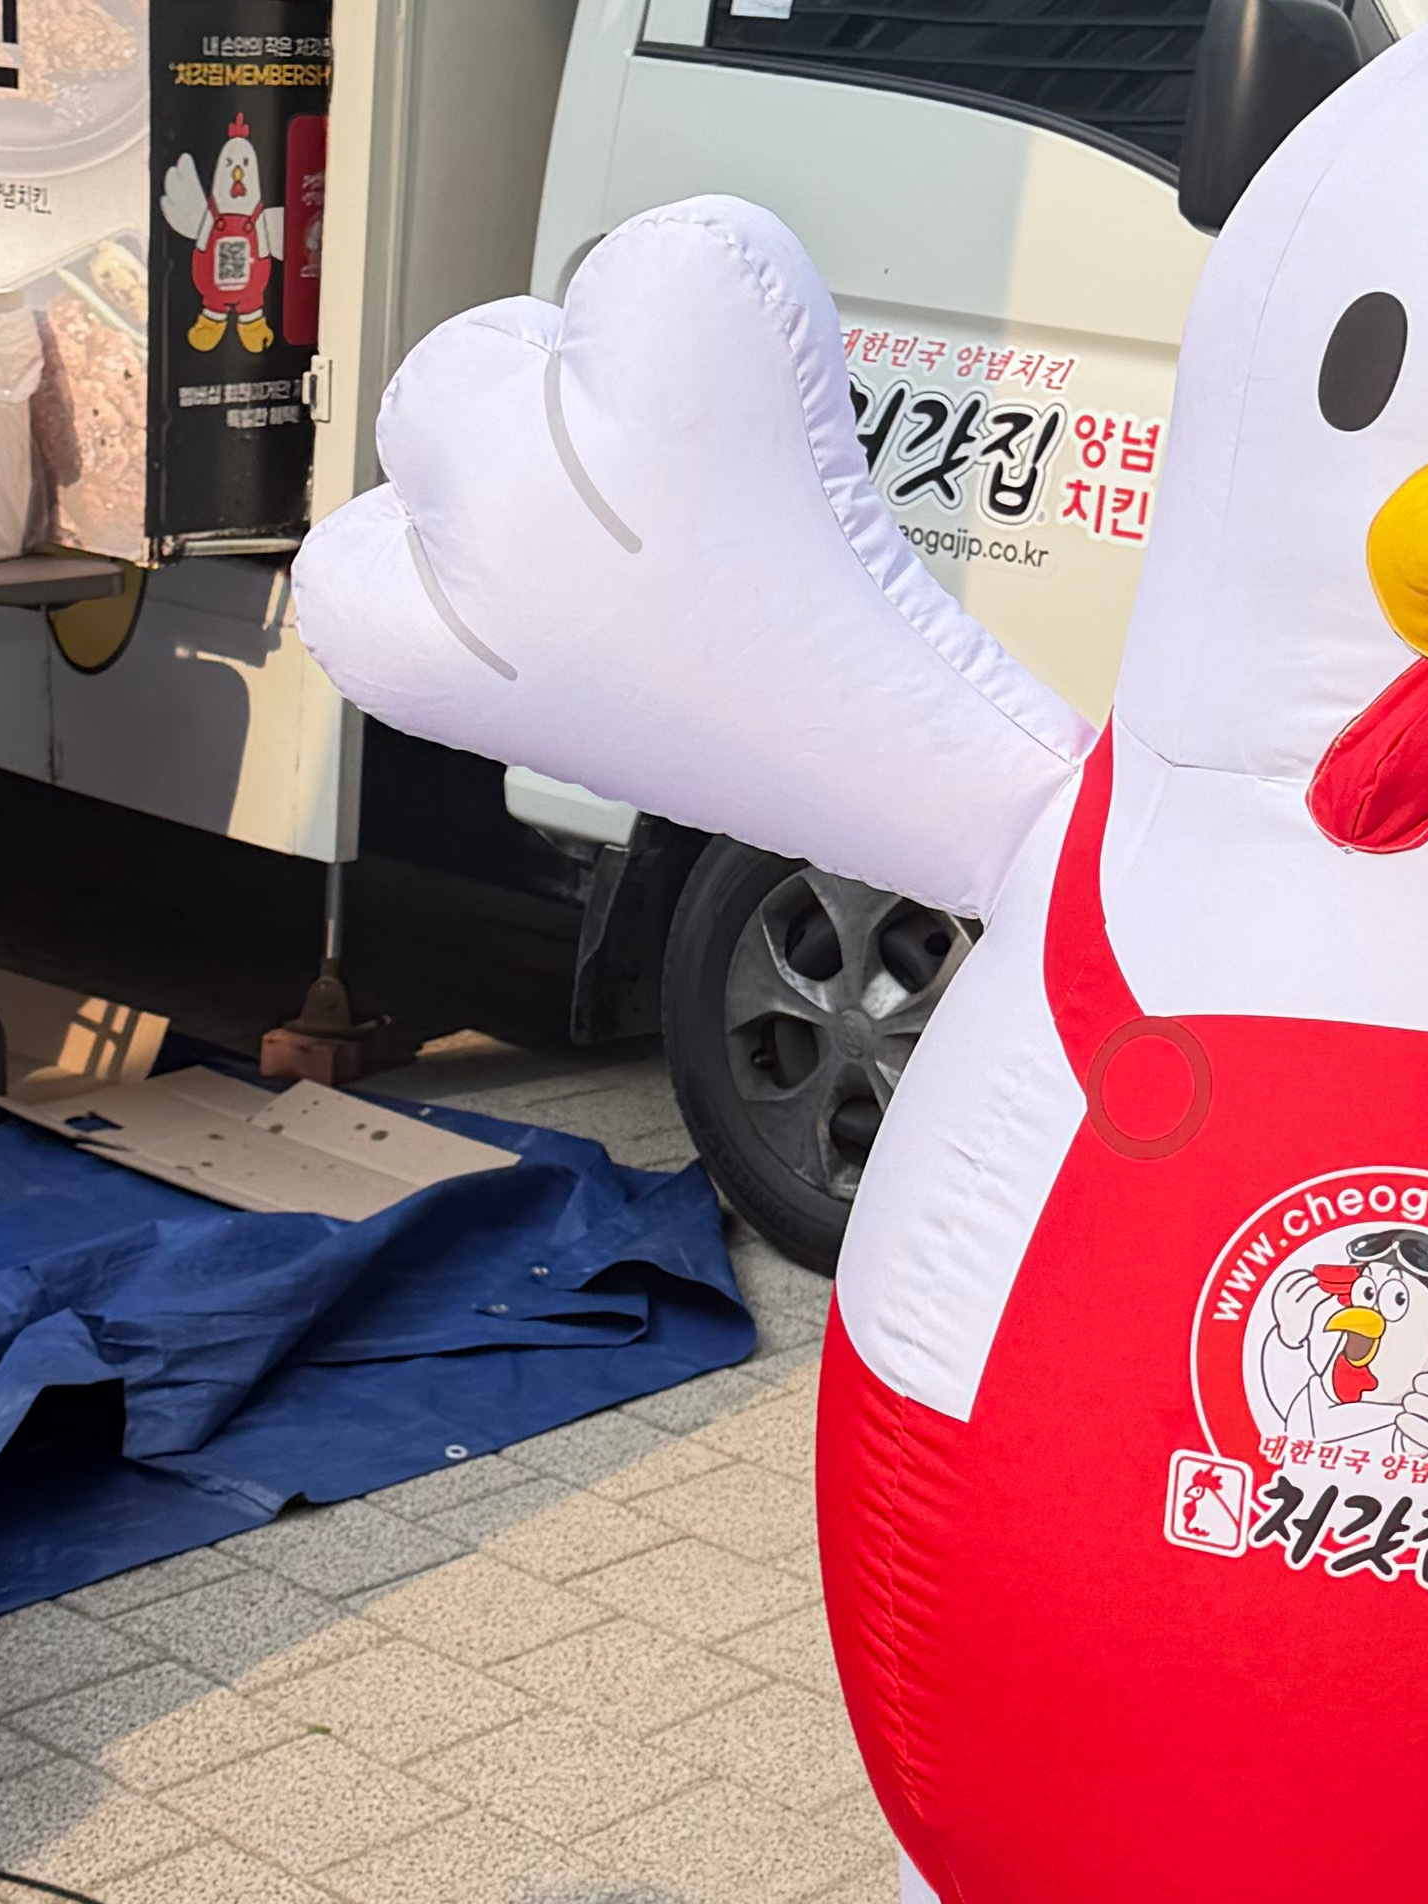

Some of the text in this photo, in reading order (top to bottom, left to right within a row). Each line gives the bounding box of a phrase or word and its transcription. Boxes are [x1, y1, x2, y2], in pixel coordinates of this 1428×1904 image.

[956, 344, 1076, 392] 양념치킨
[1074, 414, 1162, 474] 양념
[1061, 478, 1150, 541] 치킨
[1258, 1433, 1371, 1475] 대한민국
